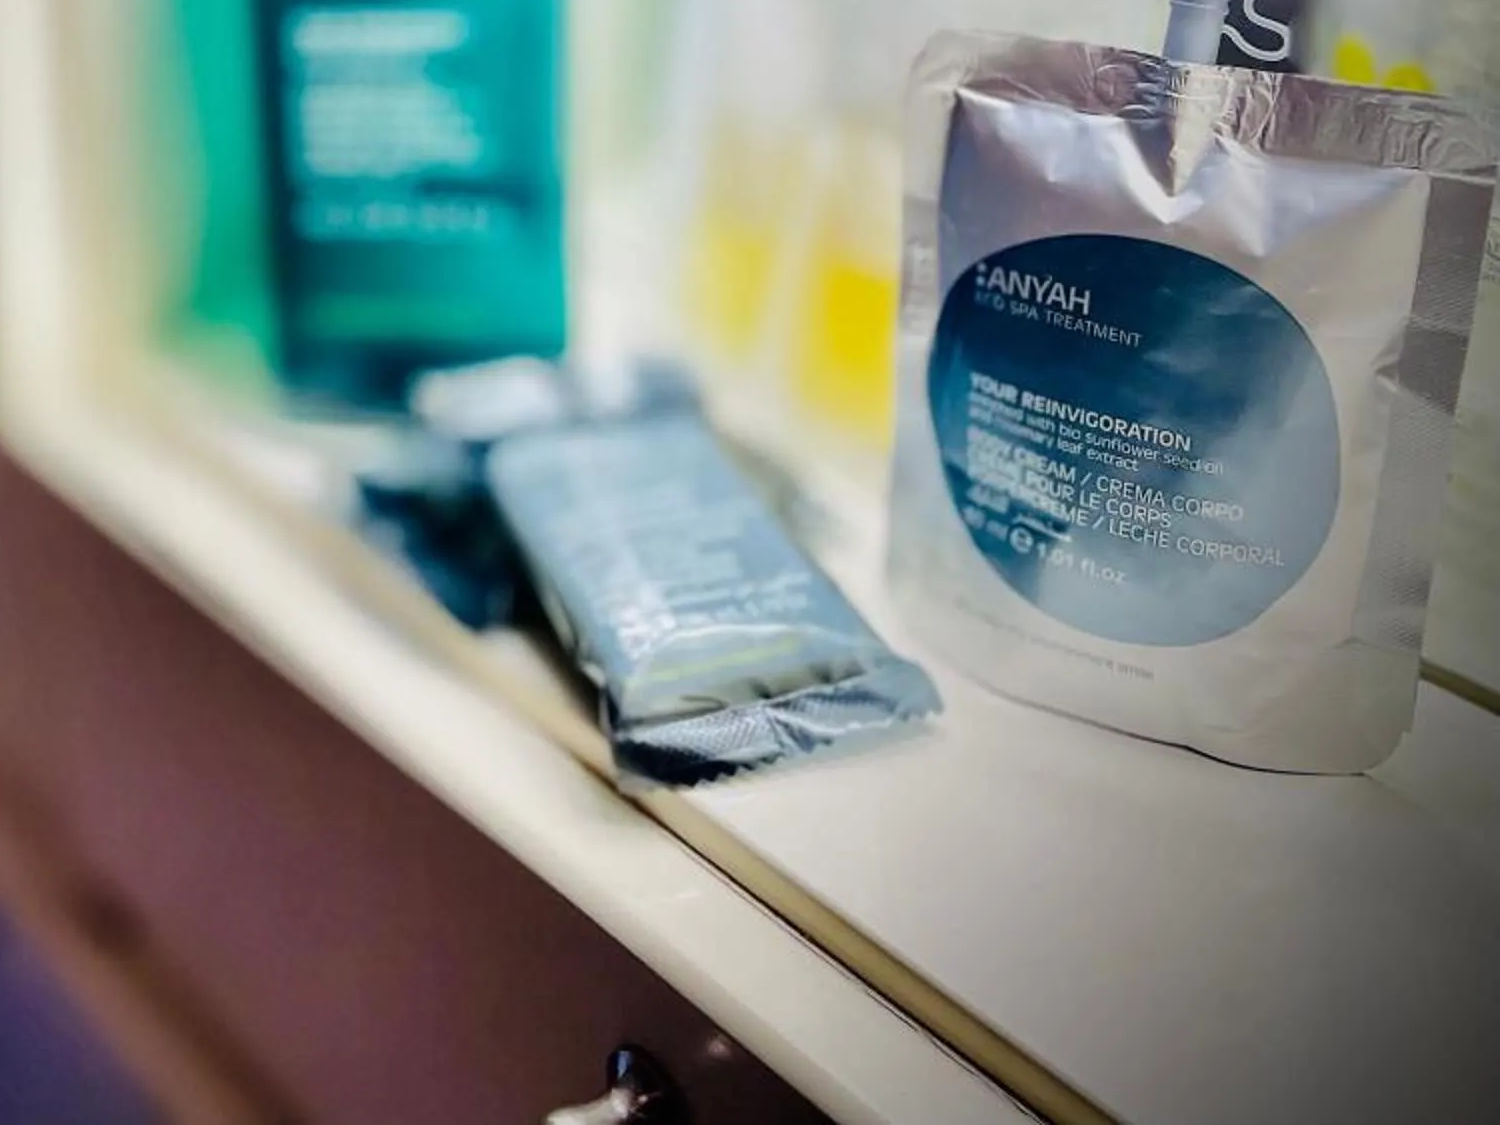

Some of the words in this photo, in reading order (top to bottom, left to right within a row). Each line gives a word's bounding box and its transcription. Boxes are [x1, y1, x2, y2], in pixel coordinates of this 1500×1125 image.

[1009, 299, 1039, 321] SPA
[1043, 307, 1143, 347] TREATMENT
[970, 372, 1018, 403] YOUR
[1020, 390, 1192, 452] REINVIGORATION
[1057, 435, 1084, 455] leaf
[1086, 447, 1140, 473] extract
[1058, 421, 1082, 440] bio
[1085, 431, 1160, 461] sunflower
[1162, 452, 1202, 473] seed
[1013, 444, 1077, 483] CREAM
[1096, 476, 1166, 509] CREMA
[1172, 495, 1244, 522] CORPO
[1026, 471, 1076, 502] POUR
[1079, 487, 1101, 511] LE
[1106, 497, 1172, 529] CORPS
[1108, 518, 1171, 549] LECHE
[1177, 535, 1286, 567] CORPORAL
